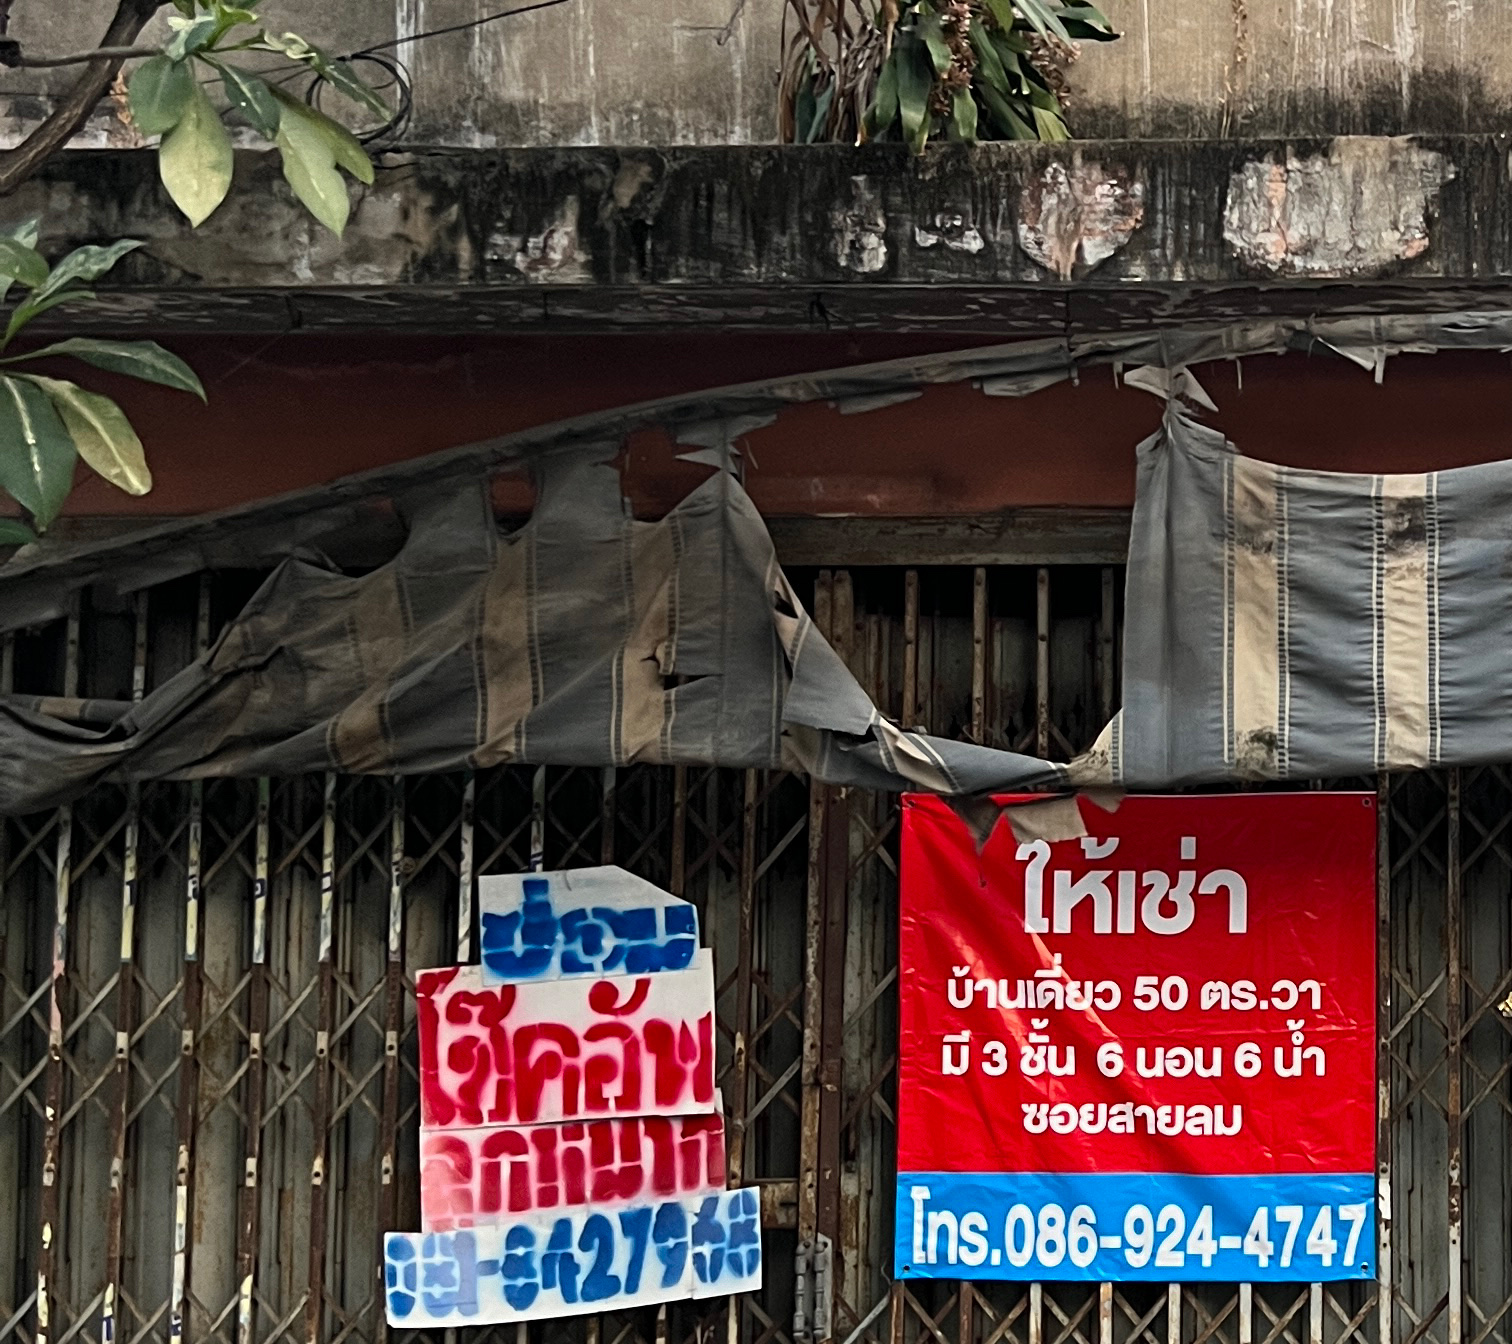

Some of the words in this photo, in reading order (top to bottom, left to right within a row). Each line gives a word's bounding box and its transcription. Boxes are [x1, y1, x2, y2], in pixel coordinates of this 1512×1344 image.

[1016, 836, 1249, 935] ให้เช่า
[946, 952, 1122, 1011] บ้านเดี่ยว
[1133, 975, 1188, 1011] 50
[1200, 975, 1322, 1012] ตร.วา
[942, 1030, 970, 1077] มี
[982, 1040, 1008, 1077] 3
[1019, 1018, 1076, 1077] ชั้น
[1096, 1042, 1124, 1078] 6
[1136, 1044, 1223, 1078] นอน
[1234, 1042, 1262, 1078] 6
[1272, 1019, 1326, 1078] น้ำ
[1021, 1100, 1244, 1137] ซอยสายลม
[911, 1185, 1367, 1269] โทร.086-924-4747
